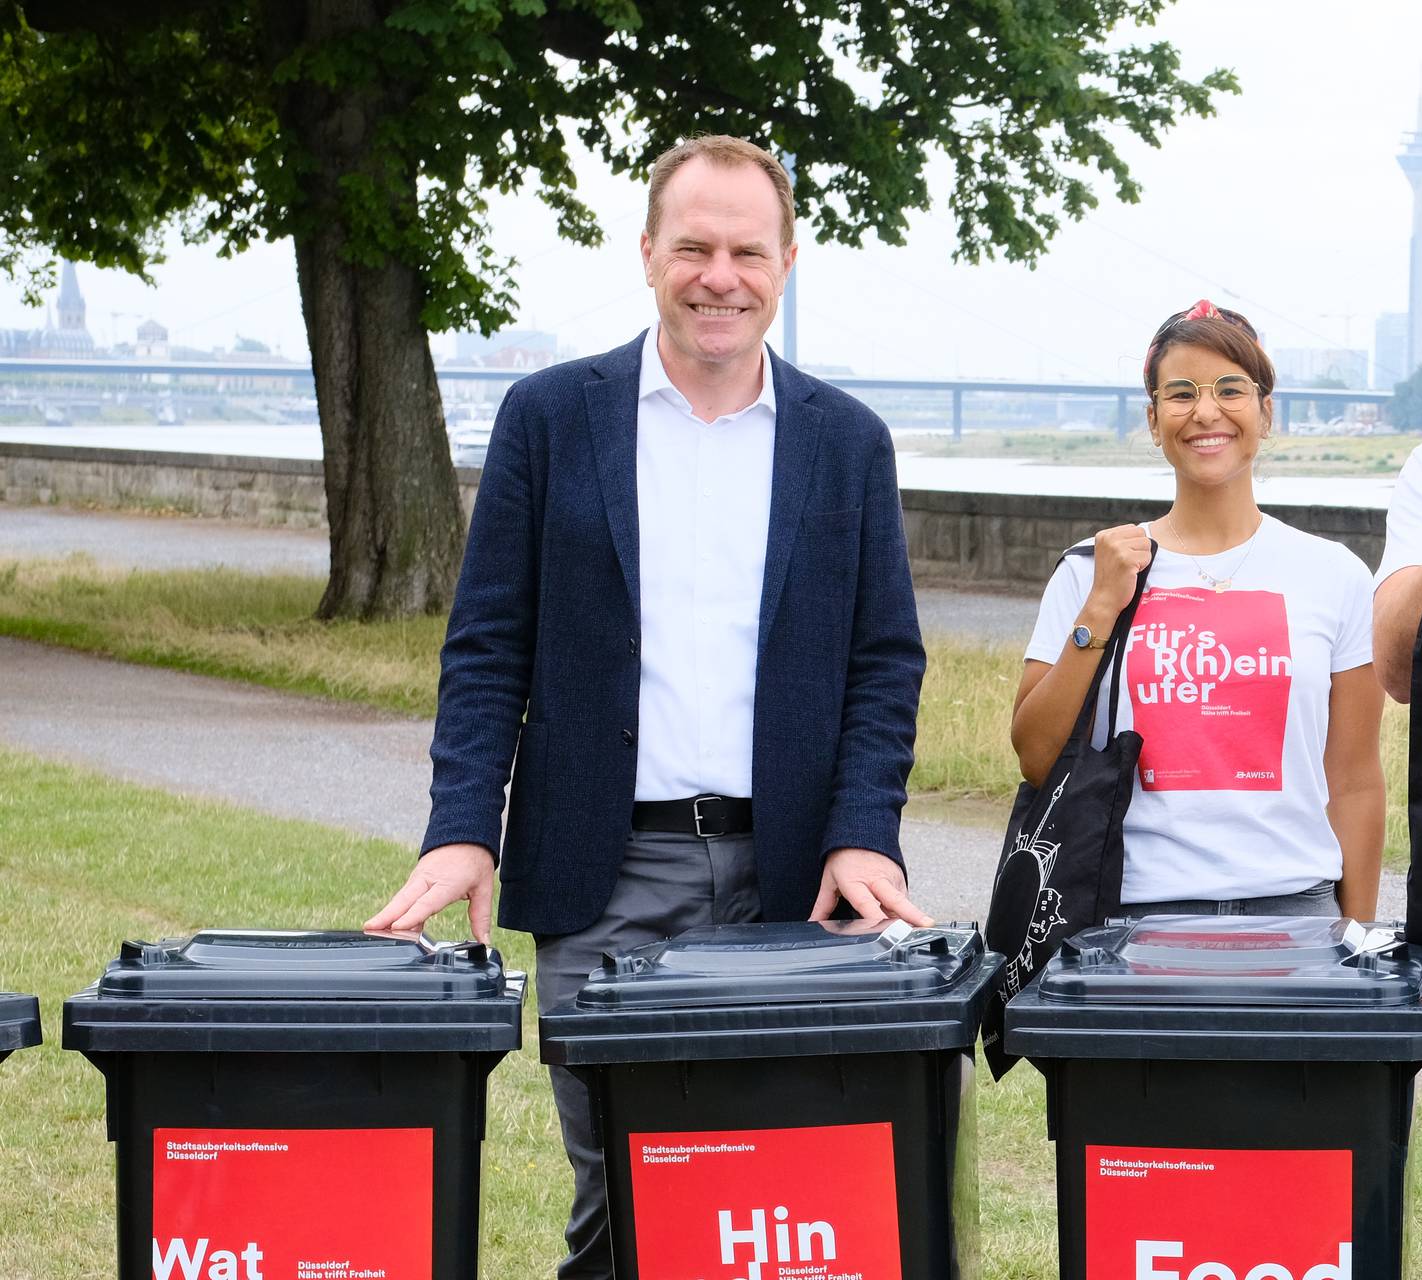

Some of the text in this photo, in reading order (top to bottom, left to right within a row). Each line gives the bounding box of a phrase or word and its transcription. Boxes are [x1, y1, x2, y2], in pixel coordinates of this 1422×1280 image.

[1126, 623, 1216, 652] Für’s
[1154, 643, 1292, 682] R(h)ein
[1137, 673, 1216, 704] ufer
[1245, 771, 1275, 779] AWISTA
[166, 1141, 289, 1152] Stadtsauberkeitsoffensive
[642, 1143, 756, 1155] Stadtsauberkeitsoffensive
[166, 1151, 218, 1160] Düsseldorf
[643, 1154, 690, 1163] Düsseldorf
[1099, 1158, 1215, 1171] Stadtsauberkeitsoffensive
[1100, 1168, 1148, 1178] Düsseldorf
[718, 1206, 836, 1265] Hin
[153, 1237, 263, 1280] Wat
[298, 1261, 350, 1270] Düsseldorf
[778, 1265, 828, 1275] Düsseldorf
[298, 1269, 386, 1279] Nähe trifft Freiheit
